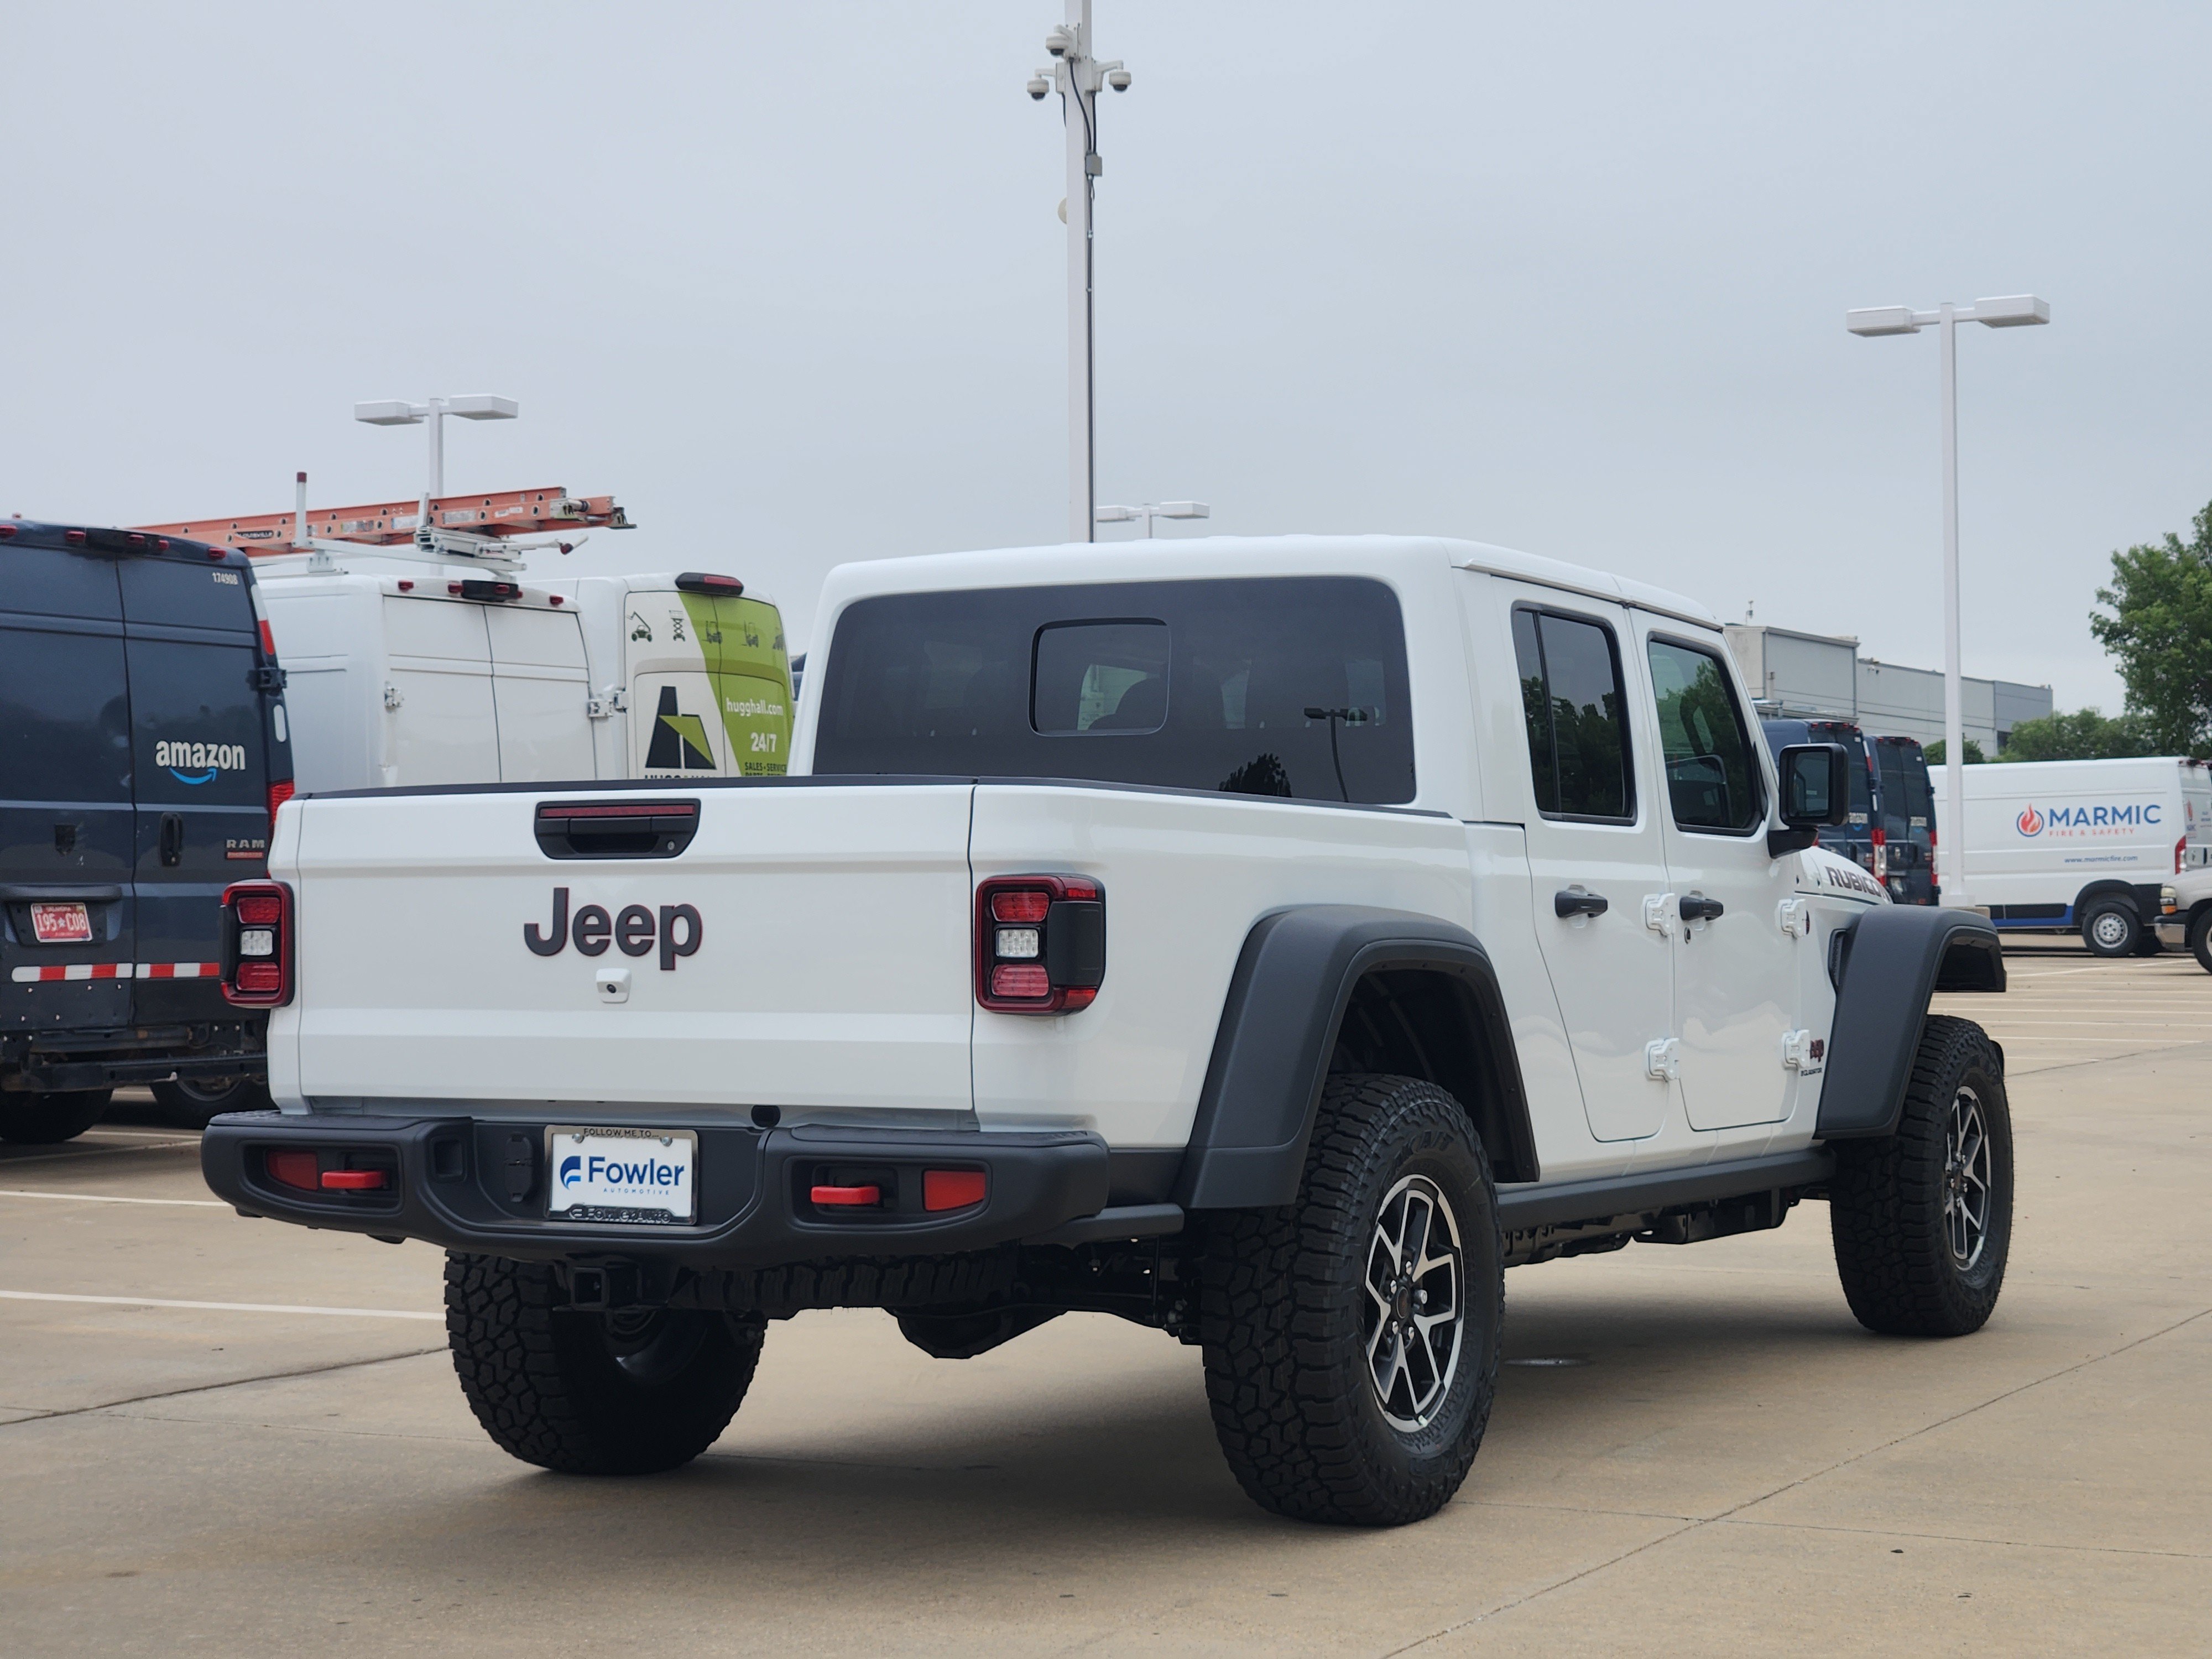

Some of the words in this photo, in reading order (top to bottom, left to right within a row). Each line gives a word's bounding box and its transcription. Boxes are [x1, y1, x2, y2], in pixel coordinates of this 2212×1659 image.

[726, 698, 783, 716] hugghall.com
[155, 740, 246, 770] amazon
[745, 761, 763, 771] SALES
[2049, 805, 2161, 827] MARMIC
[2092, 827, 2135, 836] SAFETY
[226, 839, 265, 848] RAM
[37, 913, 57, 931] 195
[524, 887, 703, 971] Jeep
[588, 1156, 685, 1186] Fowler
